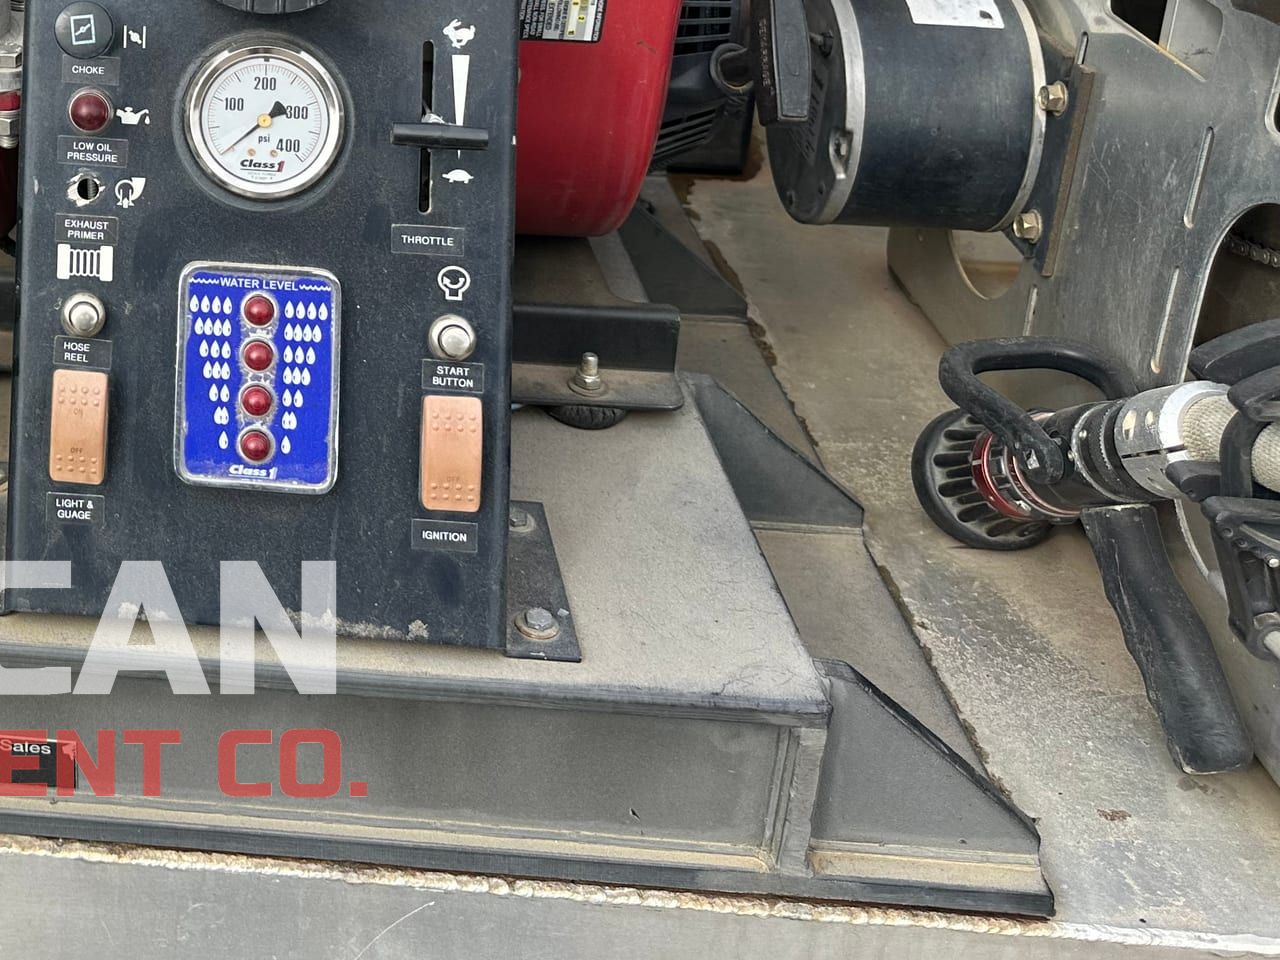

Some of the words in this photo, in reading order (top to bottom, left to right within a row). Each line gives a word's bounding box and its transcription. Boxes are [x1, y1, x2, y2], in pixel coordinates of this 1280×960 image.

[71, 65, 105, 76] CHOKE
[253, 76, 277, 92] 200
[224, 97, 245, 112] 100
[286, 106, 309, 120] 300
[258, 134, 271, 146] psi
[73, 142, 94, 152] LOW
[96, 142, 113, 152] OIL
[276, 139, 301, 154] 400
[66, 152, 118, 163] PRESSURE
[64, 219, 109, 231] EXHAUST
[67, 230, 104, 241] PRIMER
[401, 234, 454, 246] THROTTLE
[220, 277, 260, 290] WATER
[263, 280, 299, 292] LEVEL
[63, 342, 91, 353] HOSE
[64, 352, 89, 363] REEL
[436, 366, 470, 378] START
[432, 377, 474, 388] BUTTON
[55, 498, 83, 510] LIGHT
[84, 499, 94, 510] &
[57, 509, 92, 520] GUAGE
[422, 530, 468, 542] IGNITION
[0, 738, 52, 756] Sales
